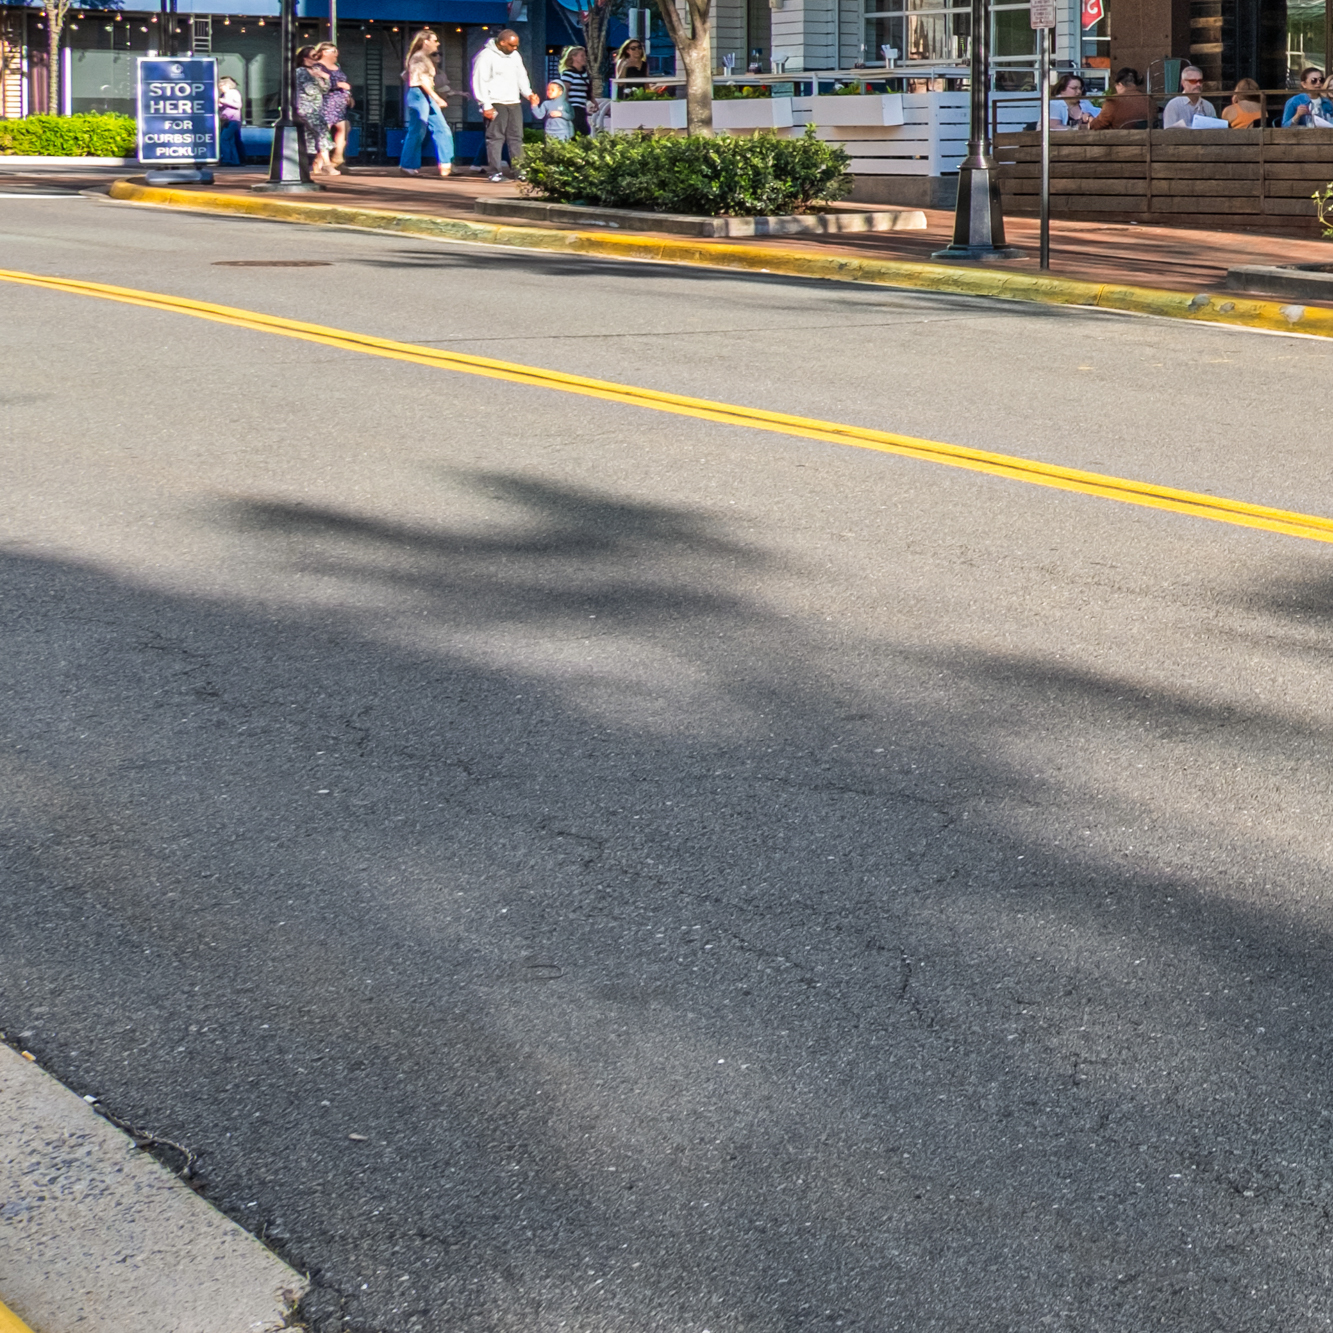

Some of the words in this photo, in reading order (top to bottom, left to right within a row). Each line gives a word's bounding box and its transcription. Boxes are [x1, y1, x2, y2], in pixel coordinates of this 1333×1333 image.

[148, 82, 205, 97] STOP
[149, 100, 205, 114] HERE
[164, 120, 193, 130] FOR
[144, 133, 214, 144] CURBSIDE
[156, 146, 207, 157] PICKUP
